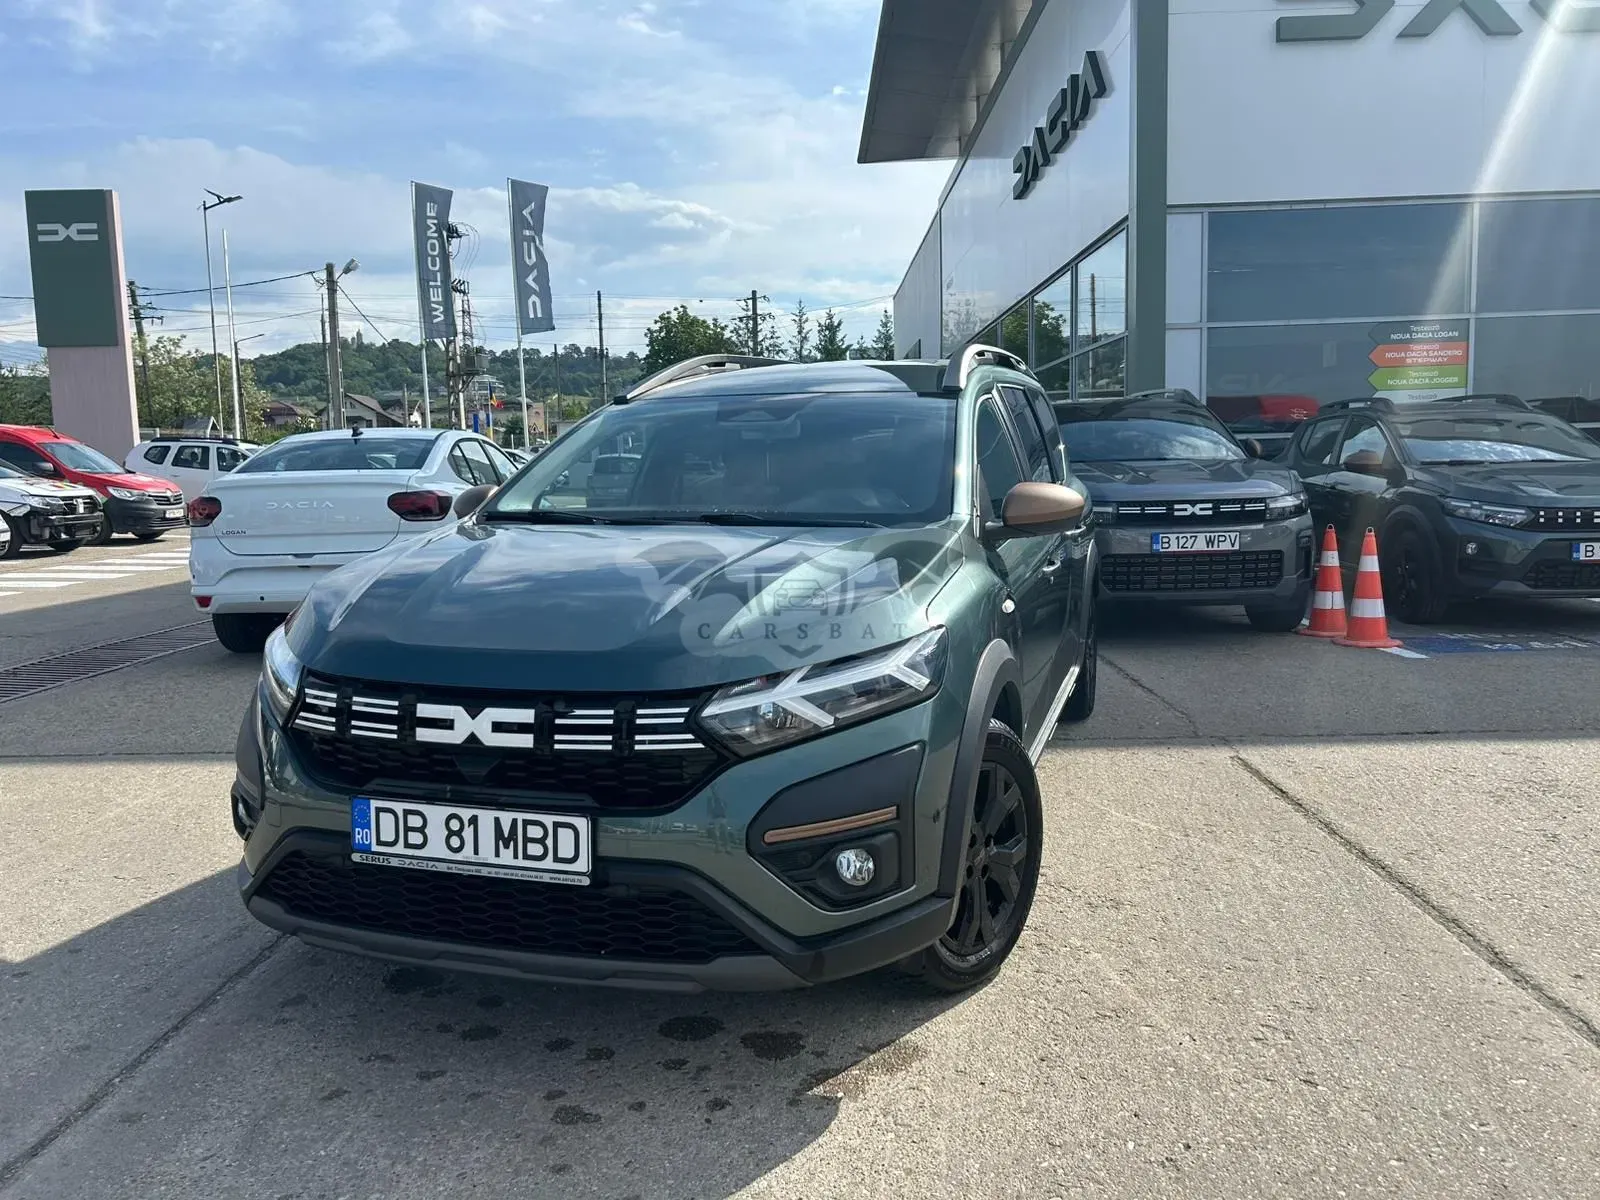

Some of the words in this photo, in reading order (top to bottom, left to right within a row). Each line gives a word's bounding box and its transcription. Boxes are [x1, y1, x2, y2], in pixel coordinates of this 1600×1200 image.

[426, 202, 445, 324] WELCOME
[522, 202, 544, 319] DACIA
[265, 501, 334, 510] DACIA
[1161, 536, 1172, 550] B
[1176, 535, 1197, 549] 127
[1205, 534, 1238, 549] WPV
[1584, 544, 1595, 558] B
[355, 827, 371, 845] RO
[375, 806, 428, 850] DB
[444, 812, 480, 856] 81
[494, 816, 581, 865] MBD
[359, 854, 392, 865] SERUS
[397, 859, 440, 870] DACIA
